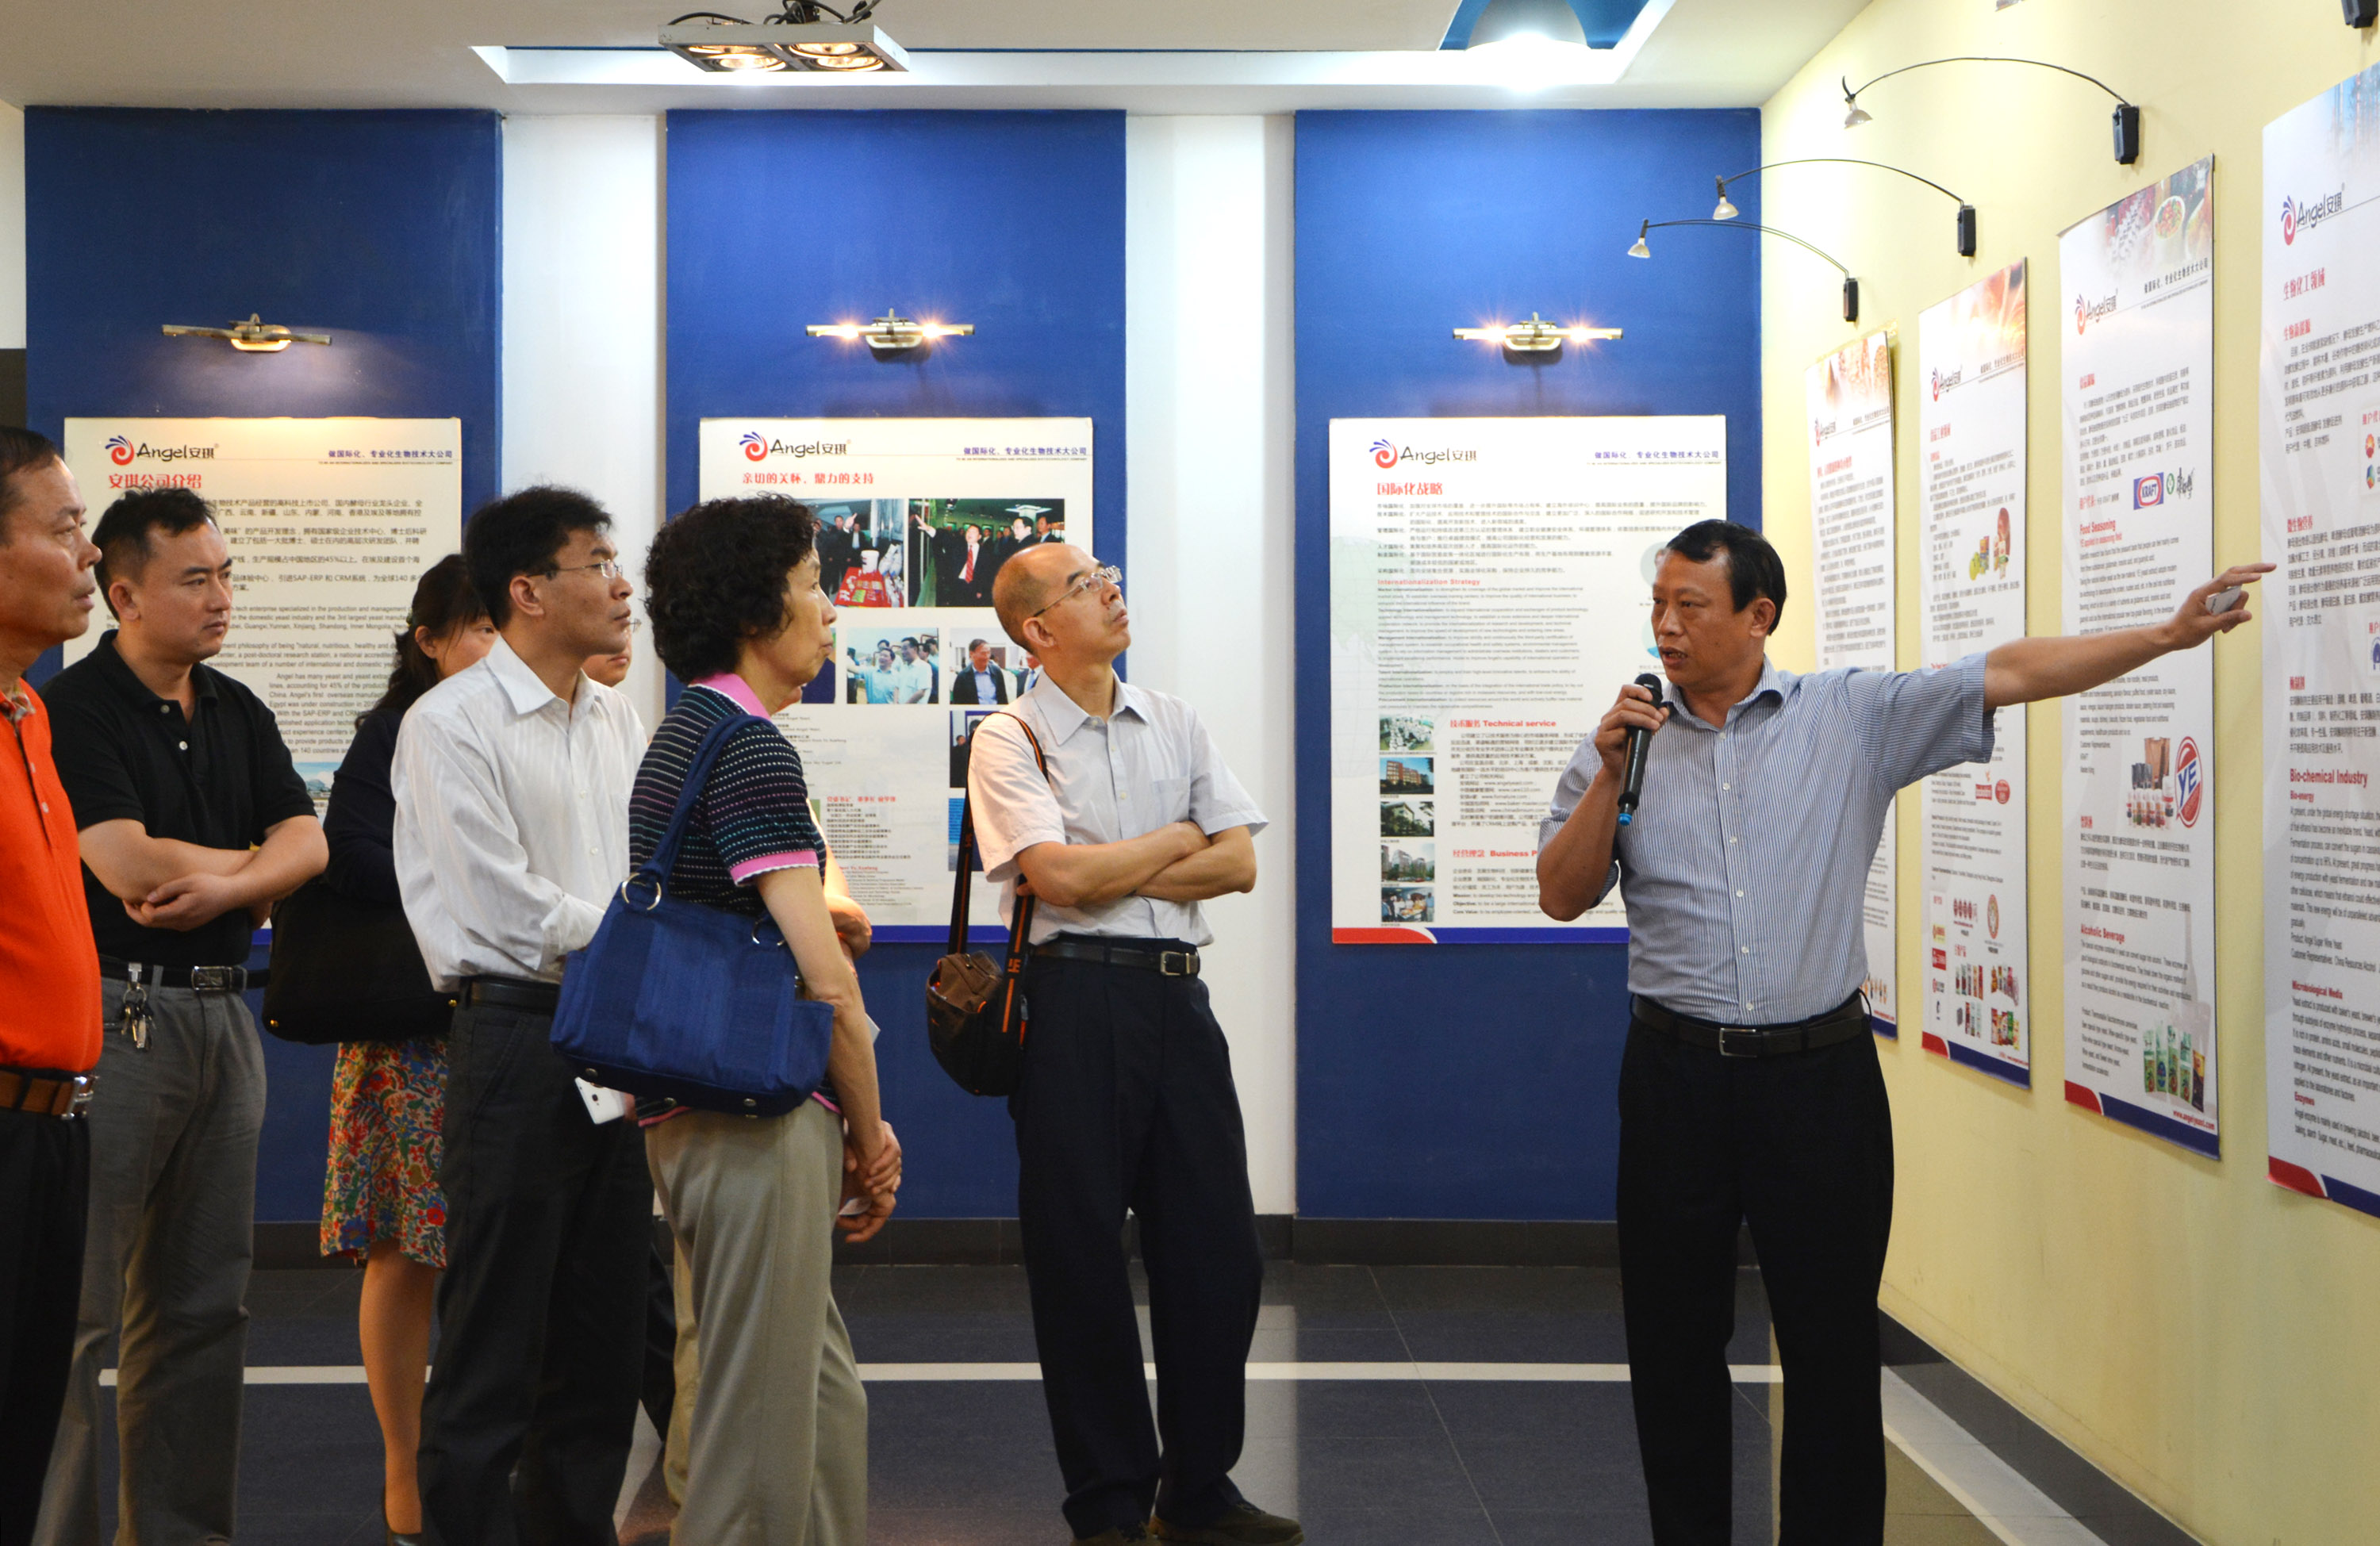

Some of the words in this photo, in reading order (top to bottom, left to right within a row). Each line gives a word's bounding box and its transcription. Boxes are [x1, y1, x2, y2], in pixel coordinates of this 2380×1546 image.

[2297, 193, 2326, 228] Angel
[136, 443, 186, 462] Angel
[770, 439, 820, 458] Angel
[1399, 445, 1450, 464] Angel
[109, 473, 202, 489] 安琪公司介绍
[1376, 481, 1443, 496] 国际化战略
[2141, 483, 2157, 498] KRAFT
[2079, 524, 2090, 535] Food
[2091, 518, 2116, 533] Seasoning
[2290, 768, 2335, 783] Bio-chemical
[2336, 769, 2368, 788] Industry
[2290, 790, 2315, 803] Bio-energy
[2080, 923, 2102, 938] Alcoholic
[2103, 926, 2125, 944] Beverage
[2292, 980, 2328, 997] Microbiological
[2328, 987, 2343, 999] Media
[2294, 1091, 2315, 1105] Enzymes
